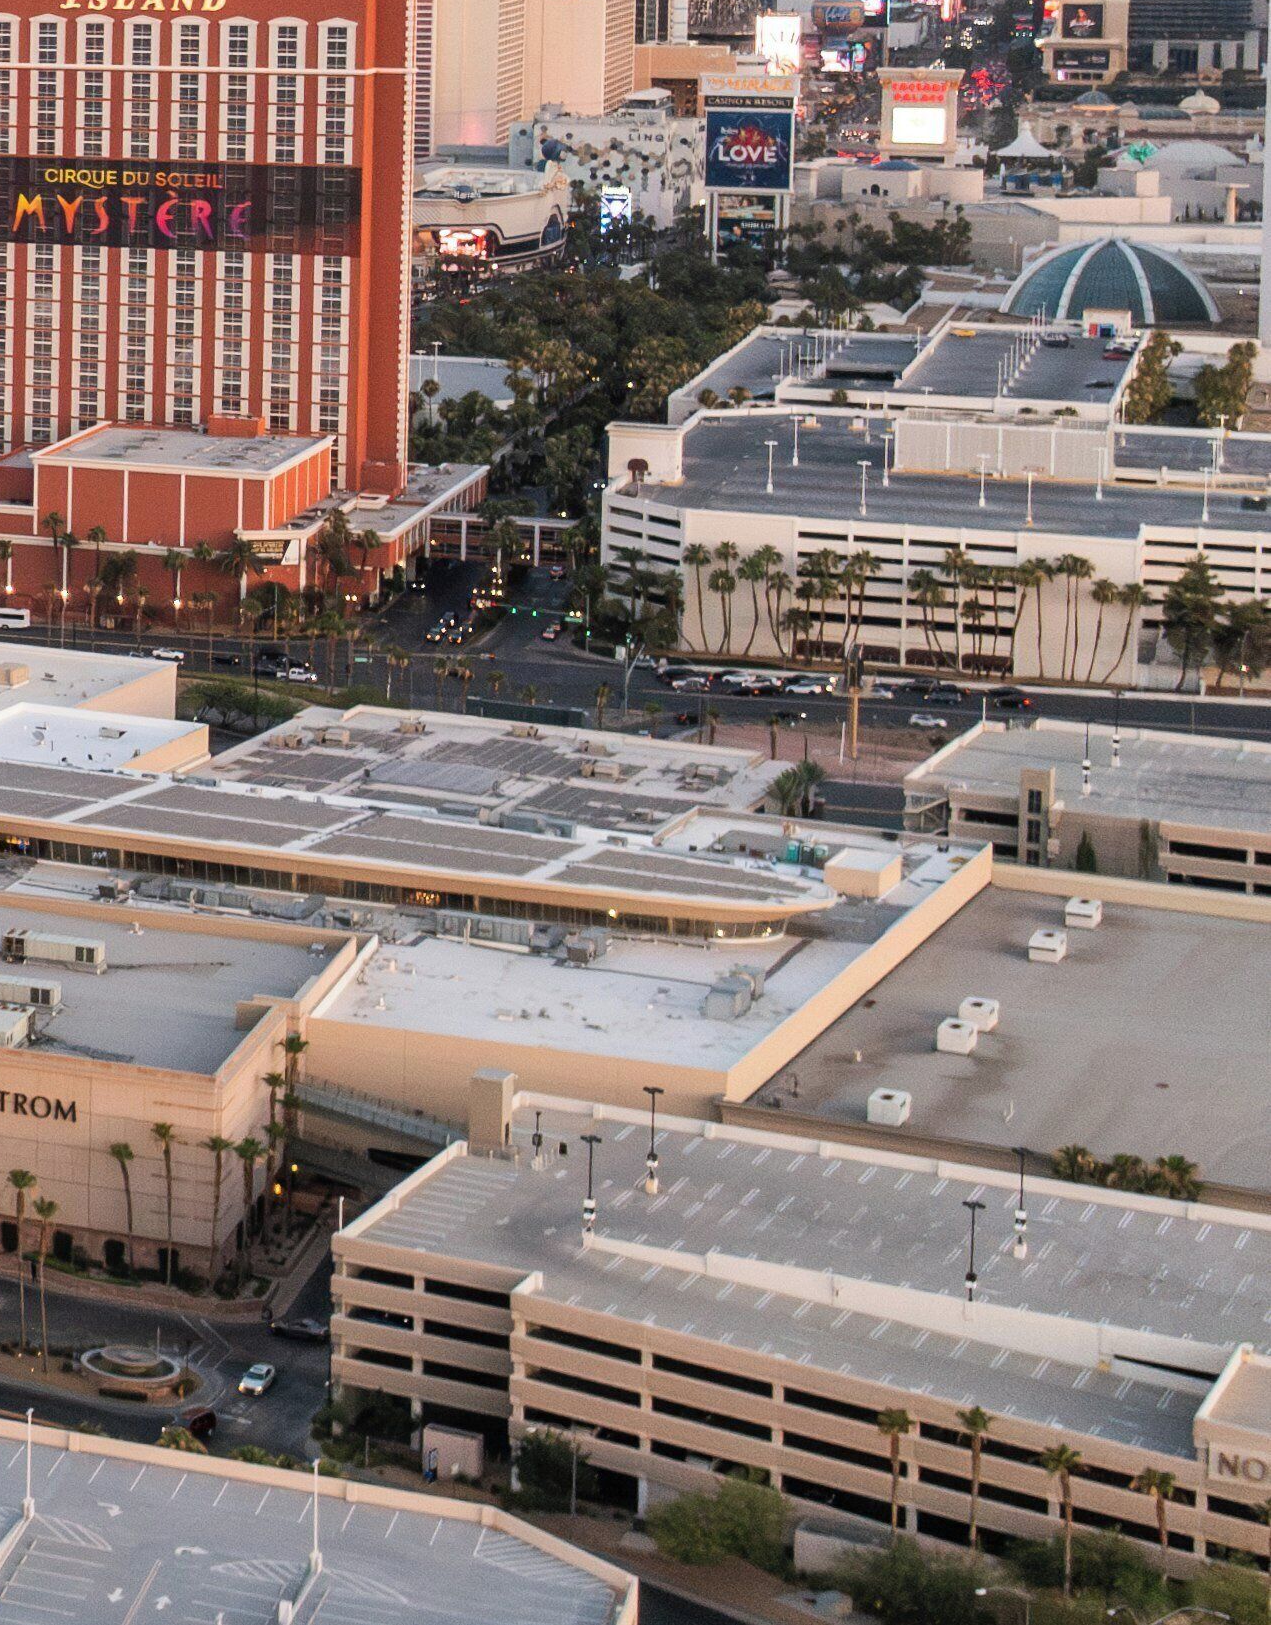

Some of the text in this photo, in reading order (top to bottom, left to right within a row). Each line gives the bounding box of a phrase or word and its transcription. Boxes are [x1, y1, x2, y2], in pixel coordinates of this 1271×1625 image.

[707, 97, 743, 106] CASINO
[754, 98, 791, 107] RESORT
[629, 133, 664, 142] LINQ
[718, 143, 777, 163] LOVE
[44, 168, 224, 189] CIRQUE DU SOLEIL
